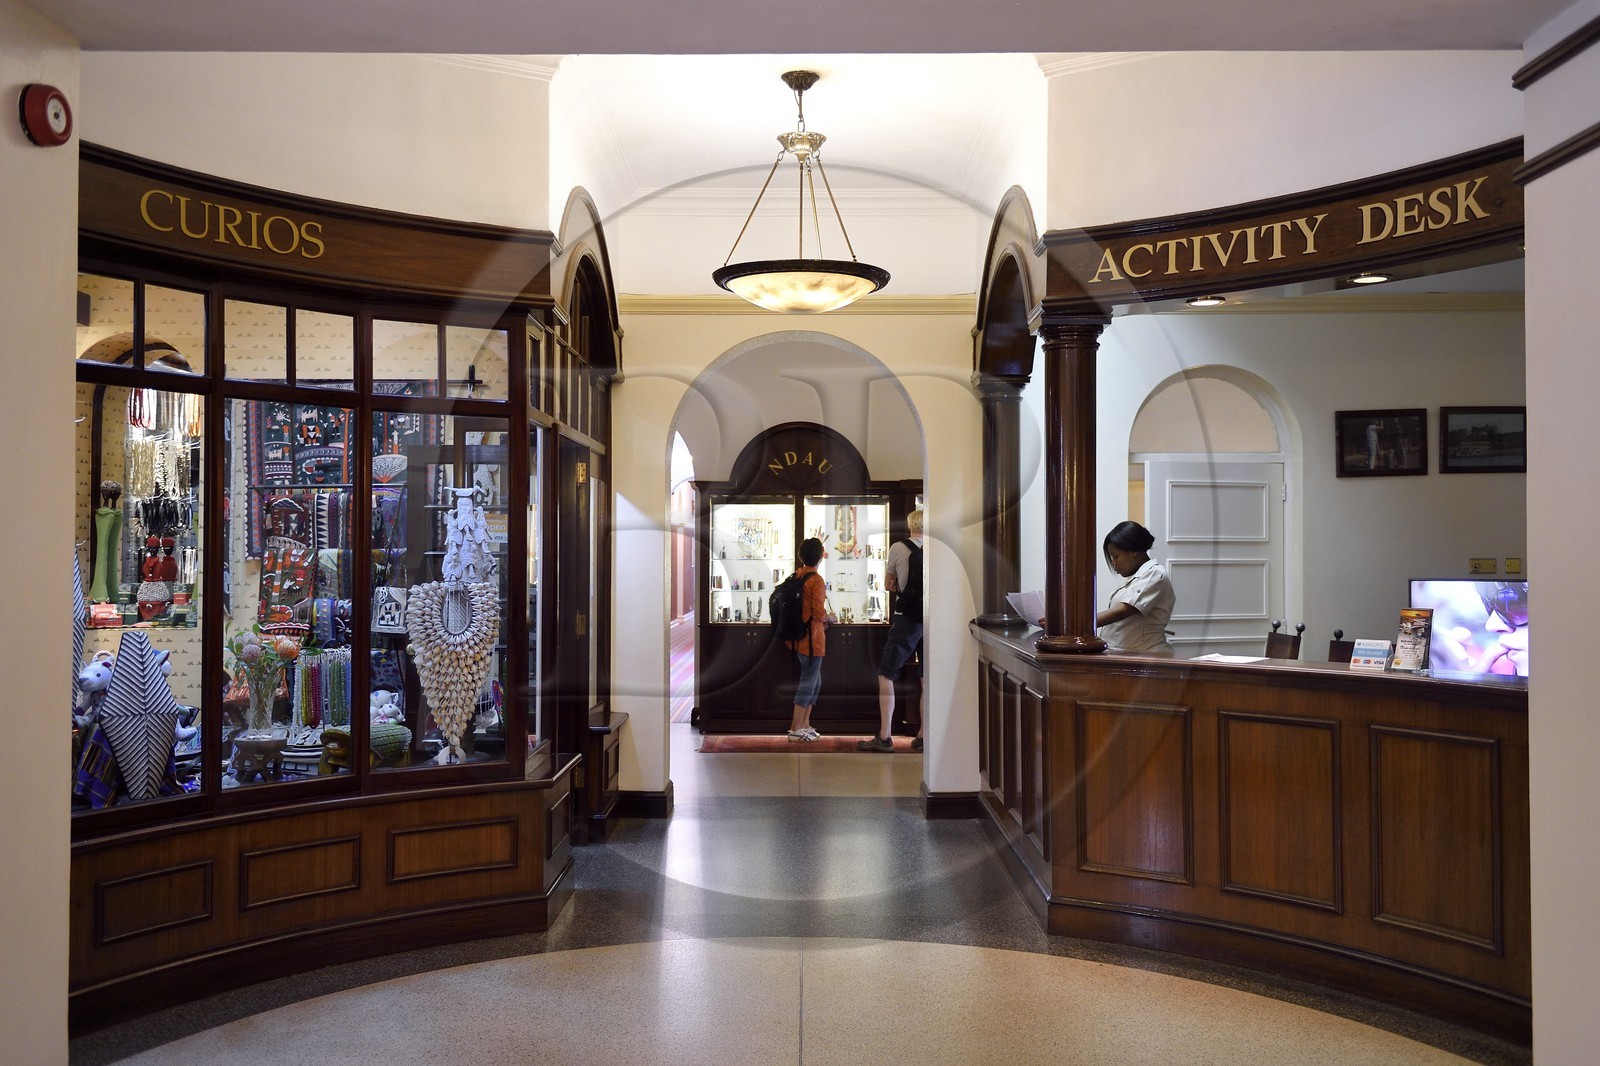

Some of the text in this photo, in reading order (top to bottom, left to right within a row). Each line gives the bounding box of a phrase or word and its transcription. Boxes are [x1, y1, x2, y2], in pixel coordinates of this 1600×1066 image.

[140, 189, 325, 259] CURIOS
[1088, 176, 1491, 284] ACTIVITY DESK
[767, 451, 833, 476] NDAU
